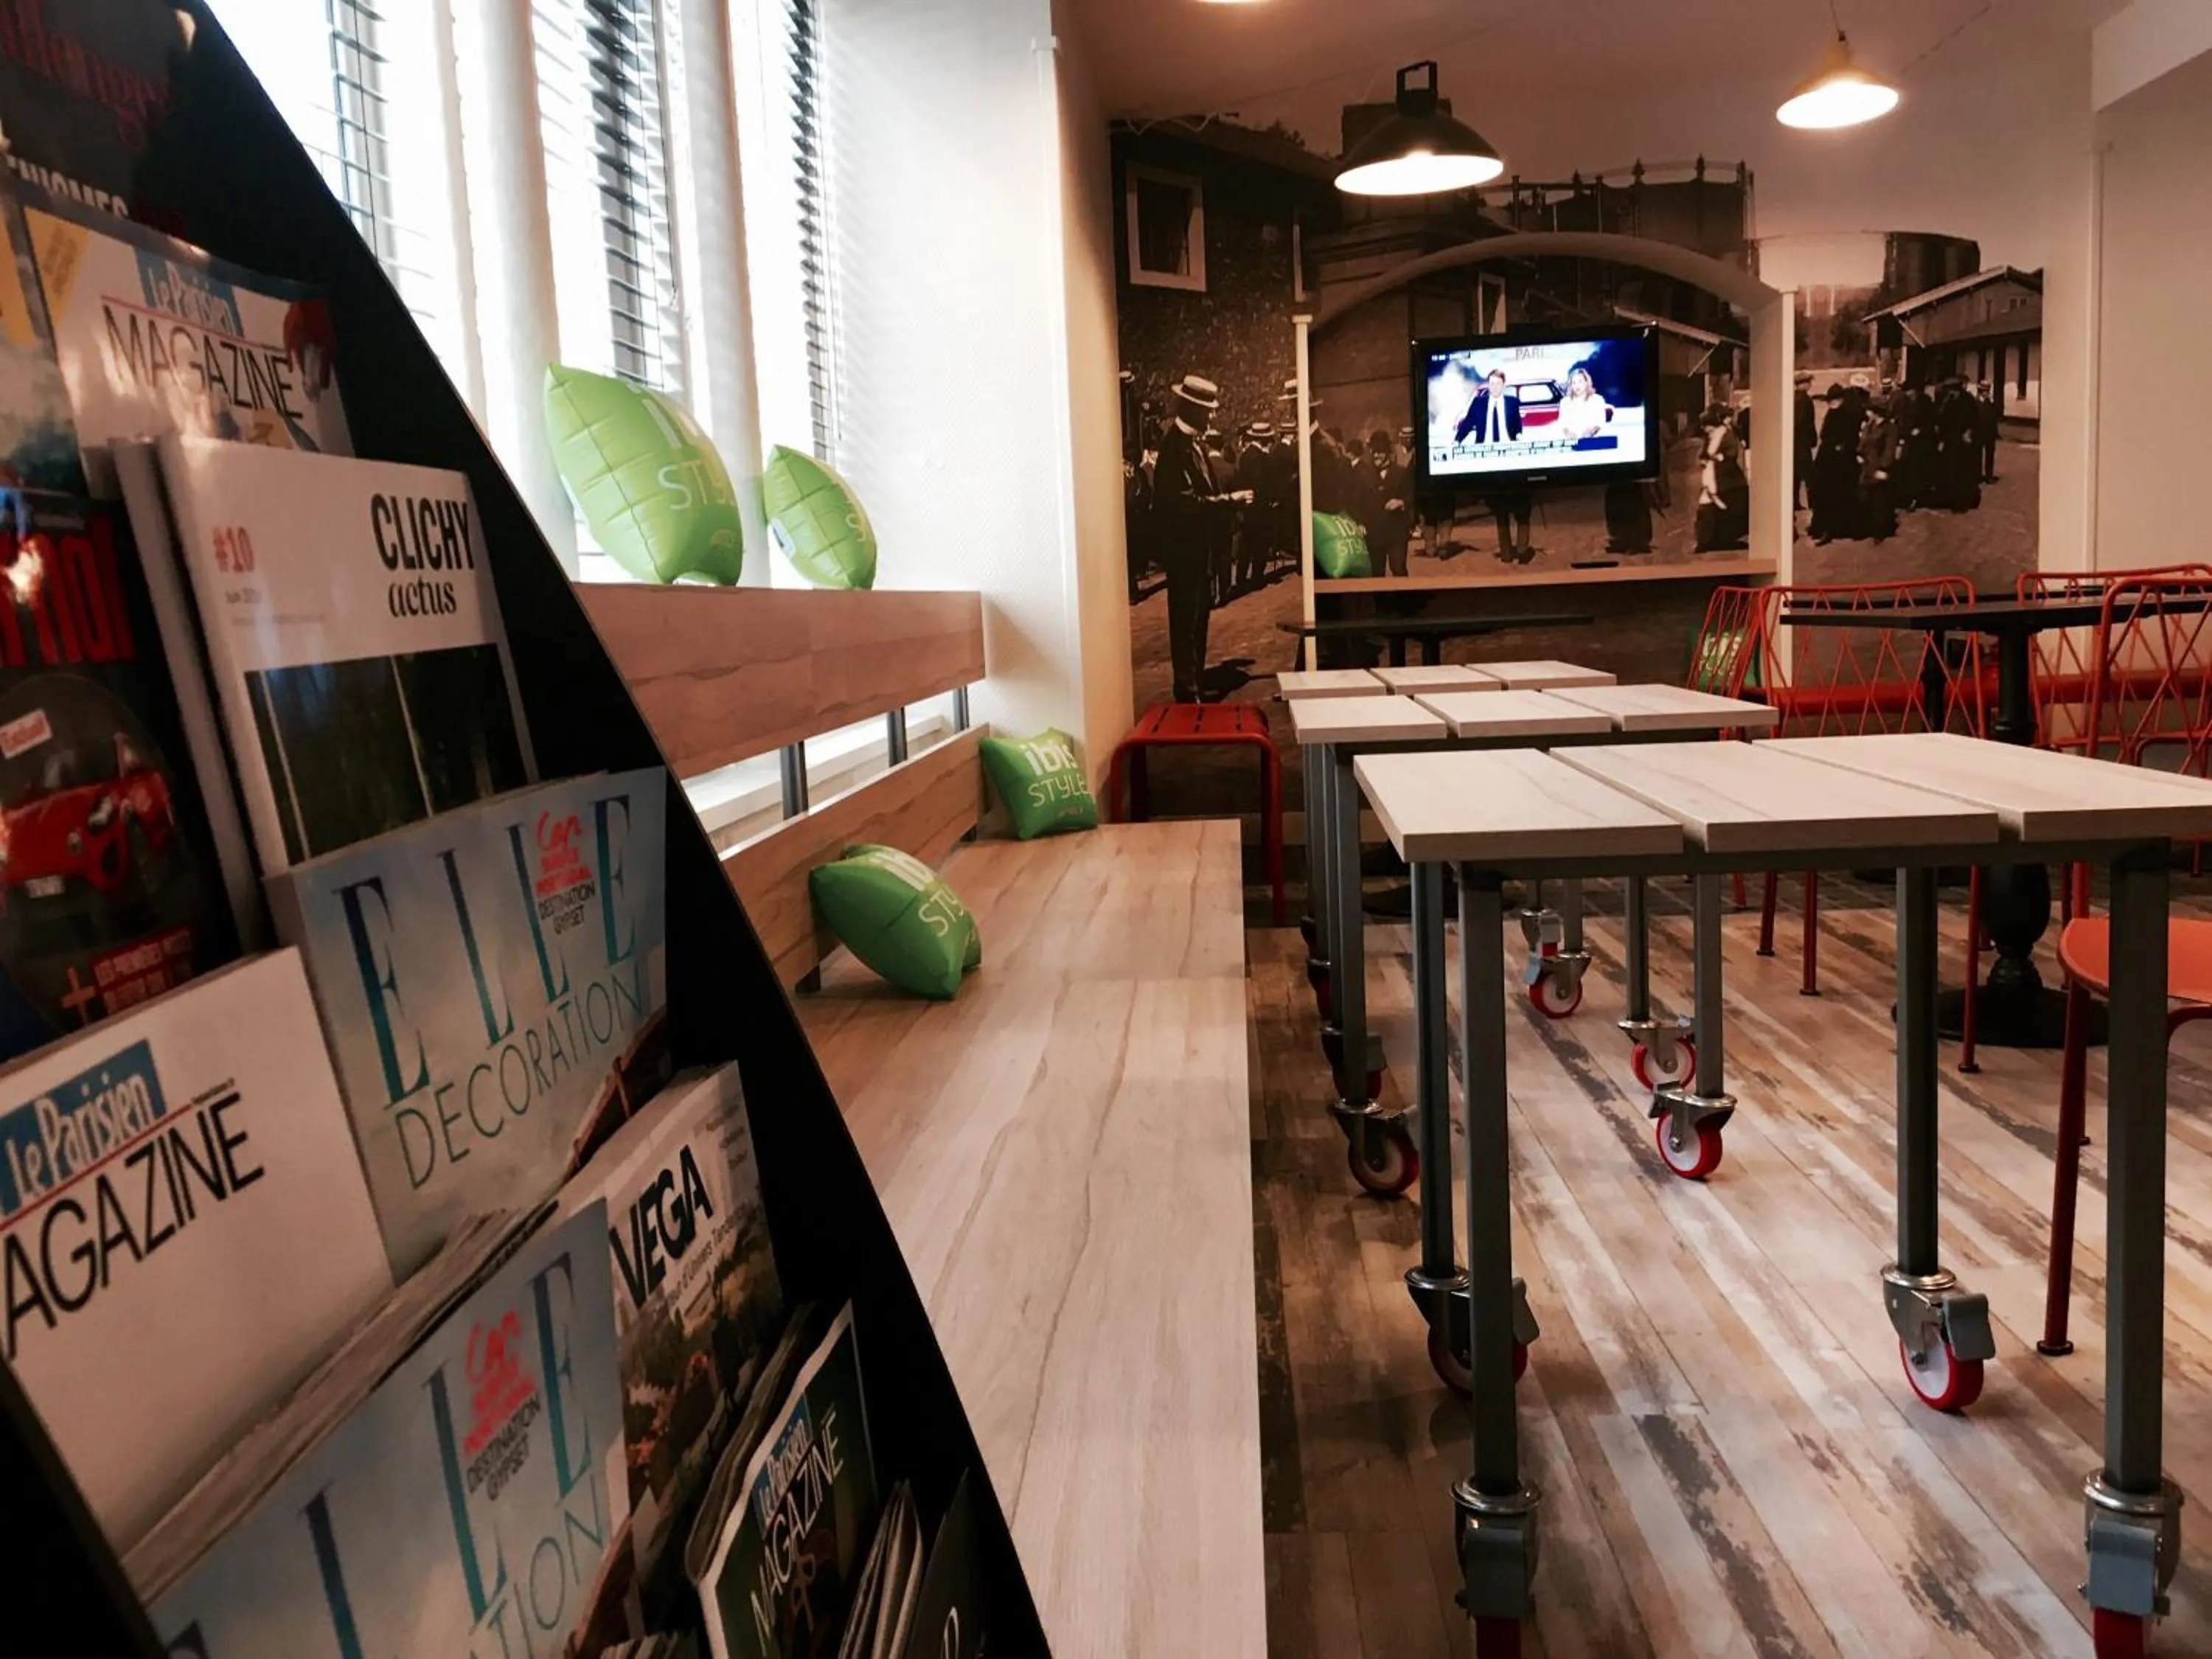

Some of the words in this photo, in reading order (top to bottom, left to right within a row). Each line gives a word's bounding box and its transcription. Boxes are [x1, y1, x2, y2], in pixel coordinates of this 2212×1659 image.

[102, 303, 304, 420] MAGAZINE
[212, 526, 255, 573] #10
[370, 493, 476, 571] CLICHY
[387, 574, 457, 618] actus
[1027, 772, 1098, 808] STYLE
[332, 794, 637, 1110] ELLE
[394, 959, 644, 1191] DECORATION
[3, 1091, 265, 1362] AGAZINE
[609, 1144, 714, 1310] VEGA
[750, 1409, 844, 1659] MAGAZINE
